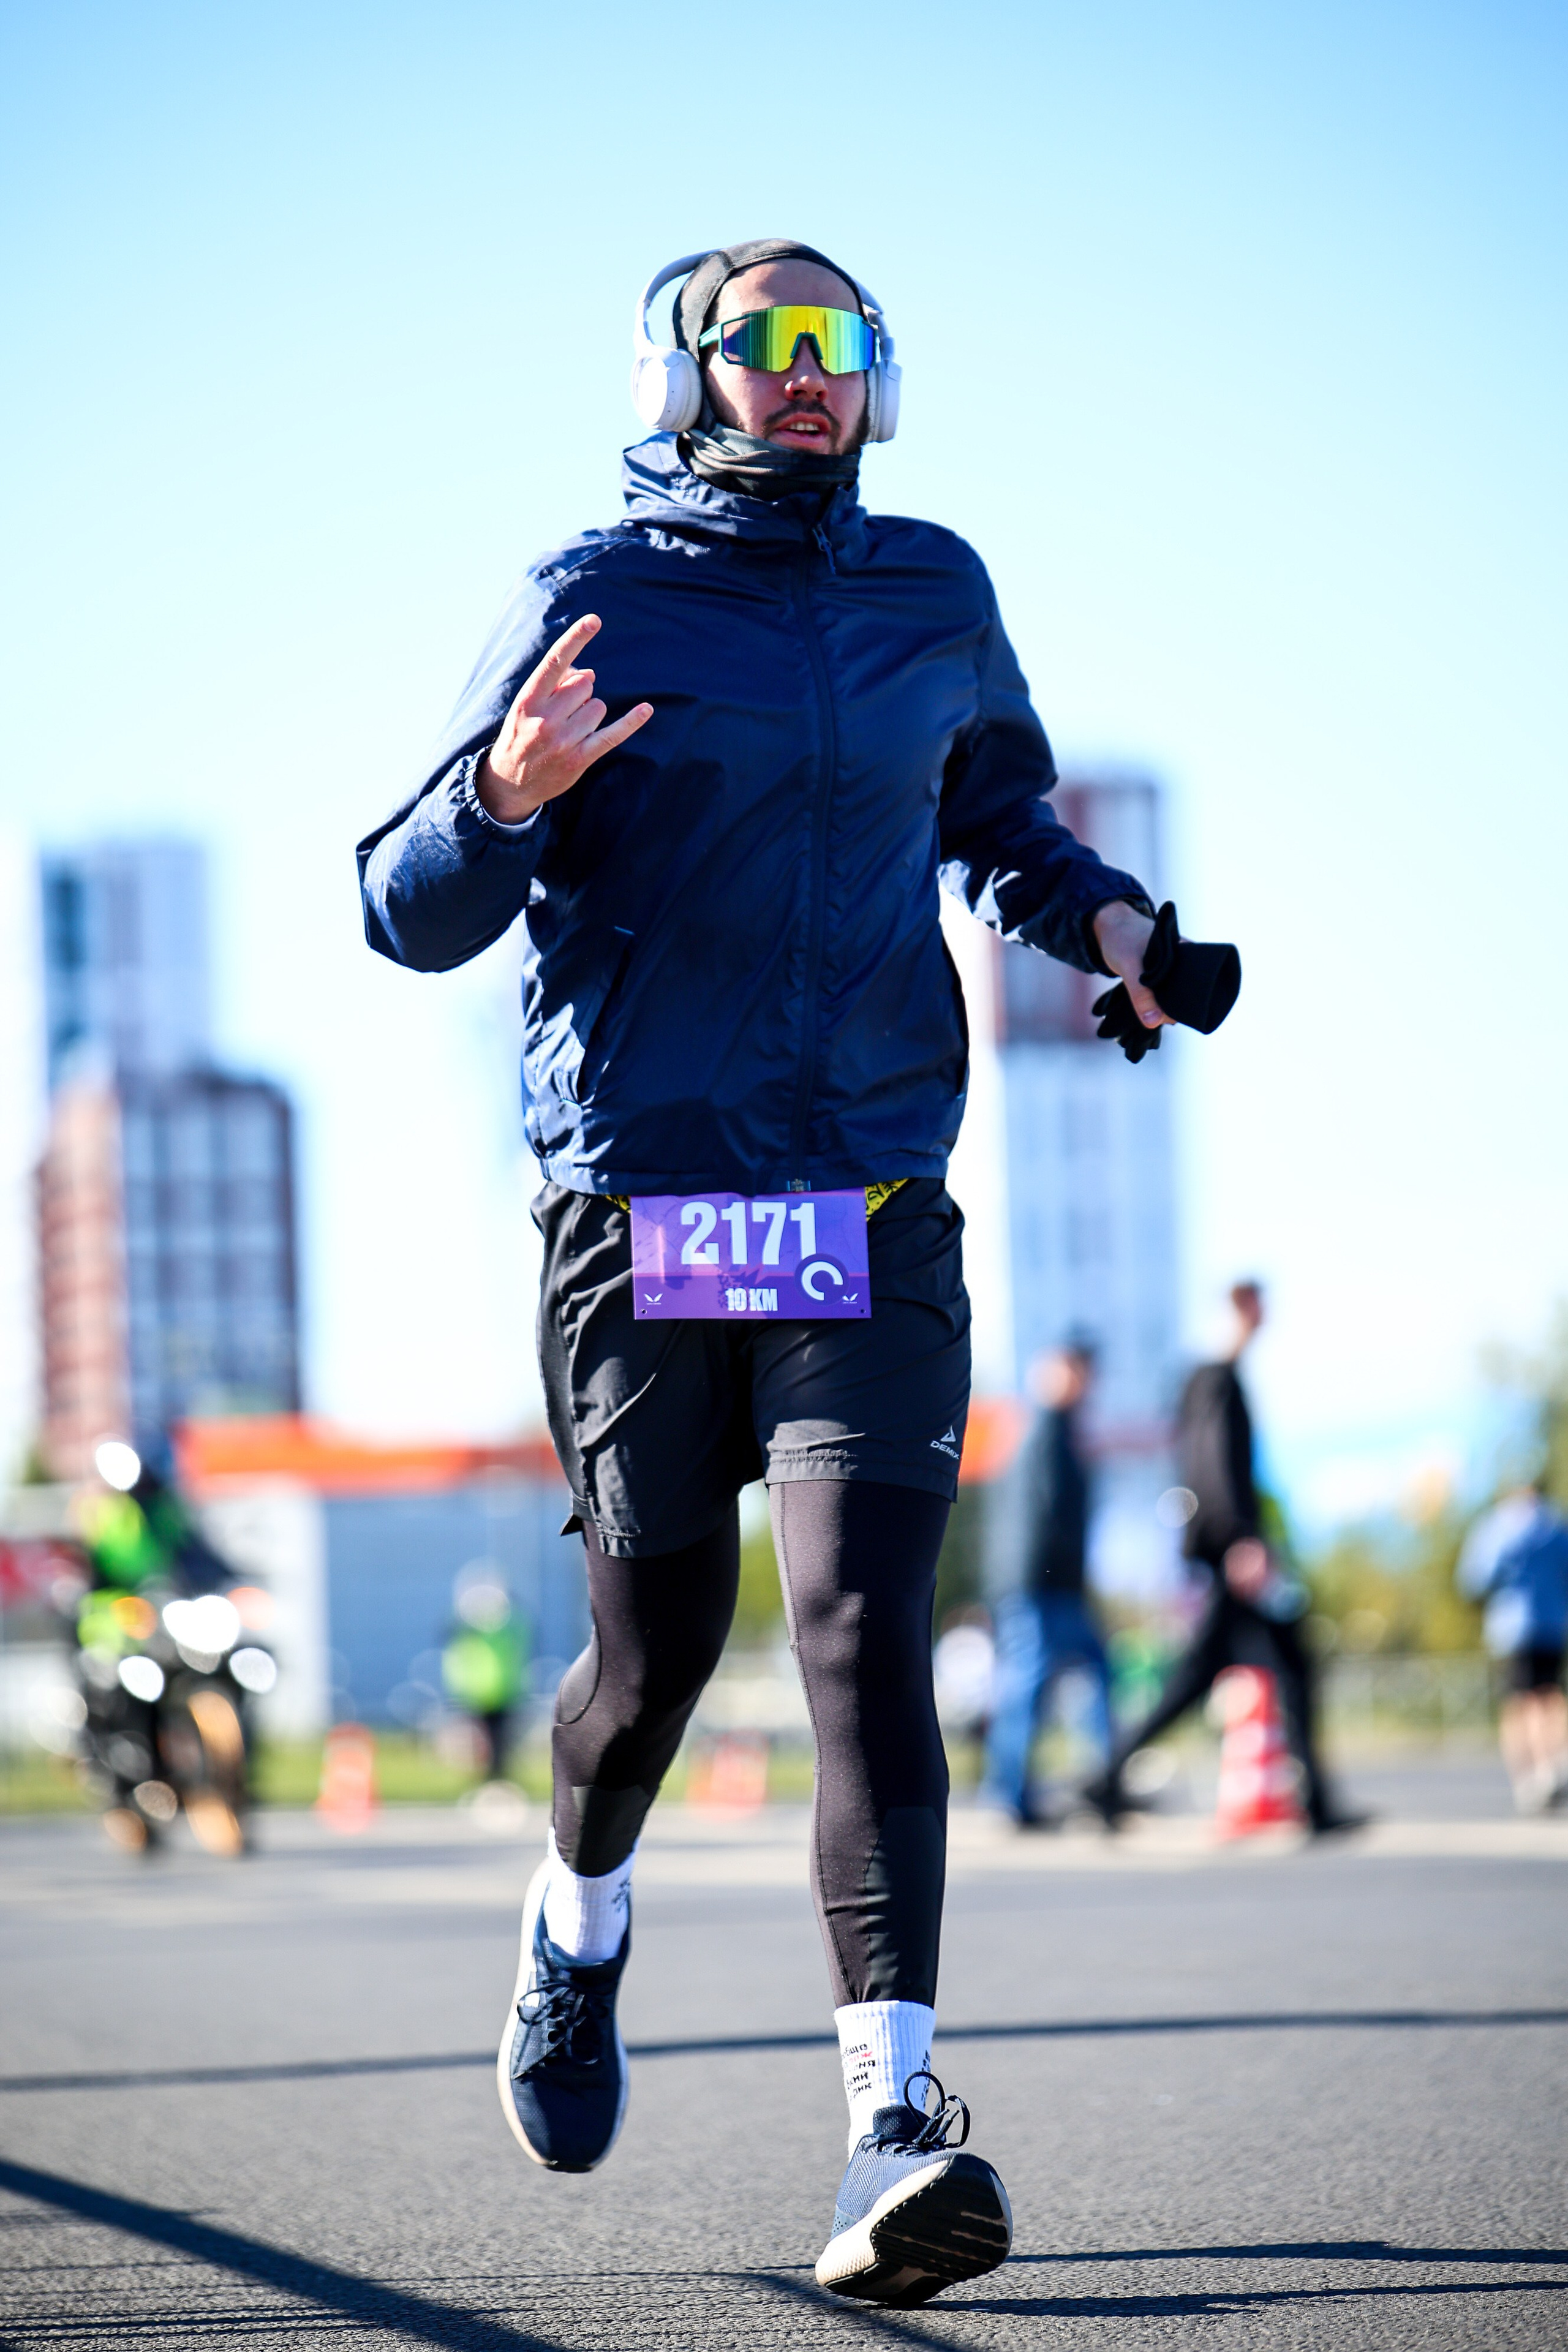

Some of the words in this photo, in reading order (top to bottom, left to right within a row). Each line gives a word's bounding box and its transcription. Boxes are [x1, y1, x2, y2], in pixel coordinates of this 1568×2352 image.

[680, 1201, 816, 1265] 2171
[725, 1287, 747, 1311] 10
[749, 1288, 778, 1311] KM
[930, 1440, 960, 1460] DEMIX
